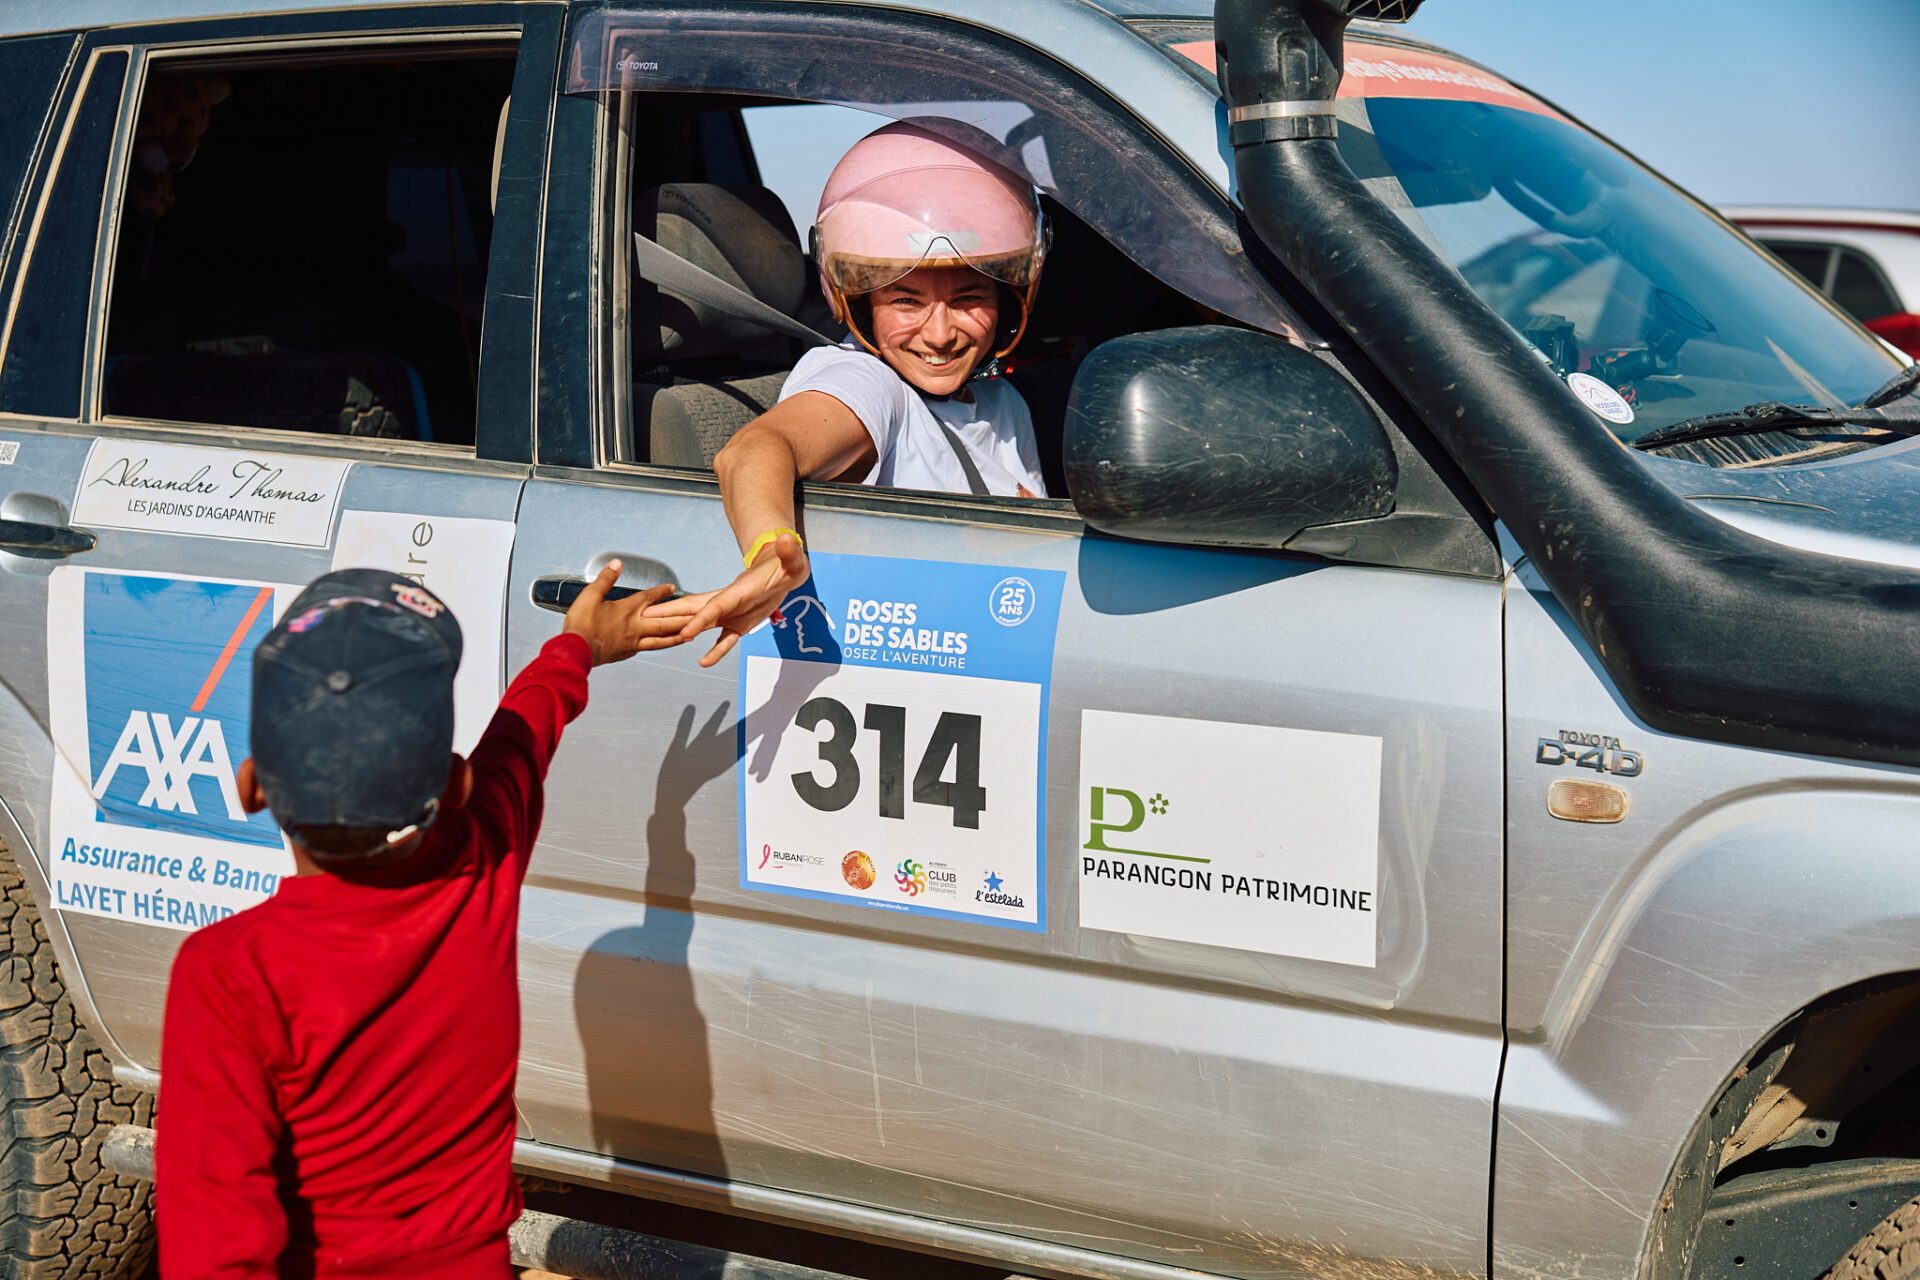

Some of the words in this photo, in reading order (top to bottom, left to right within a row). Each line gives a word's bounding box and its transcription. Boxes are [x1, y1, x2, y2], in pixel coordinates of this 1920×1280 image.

[629, 61, 659, 70] TOYOTA
[88, 458, 219, 494] Alexandre
[229, 460, 327, 504] Thomas
[127, 499, 147, 512] LES
[146, 501, 193, 517] JARDINS
[1000, 587, 1026, 607] 25
[846, 598, 918, 626] ROSES
[998, 605, 1024, 616] ANS
[843, 622, 885, 648] DES
[887, 626, 969, 656] SABLES
[843, 646, 878, 661] OSEZ
[882, 650, 967, 670] L'AVENTURE
[1558, 729, 1623, 751] TOYOTA
[91, 709, 249, 823] AXA
[791, 696, 987, 830] 314
[60, 837, 183, 880] Assurance
[187, 856, 208, 884] &
[212, 859, 285, 898] Banq
[928, 869, 957, 883] CLUB
[56, 879, 127, 915] LAYET
[1082, 857, 1213, 892] PARANGON
[1221, 874, 1372, 912] PATRIMOINE
[975, 889, 1025, 909] l'estelada
